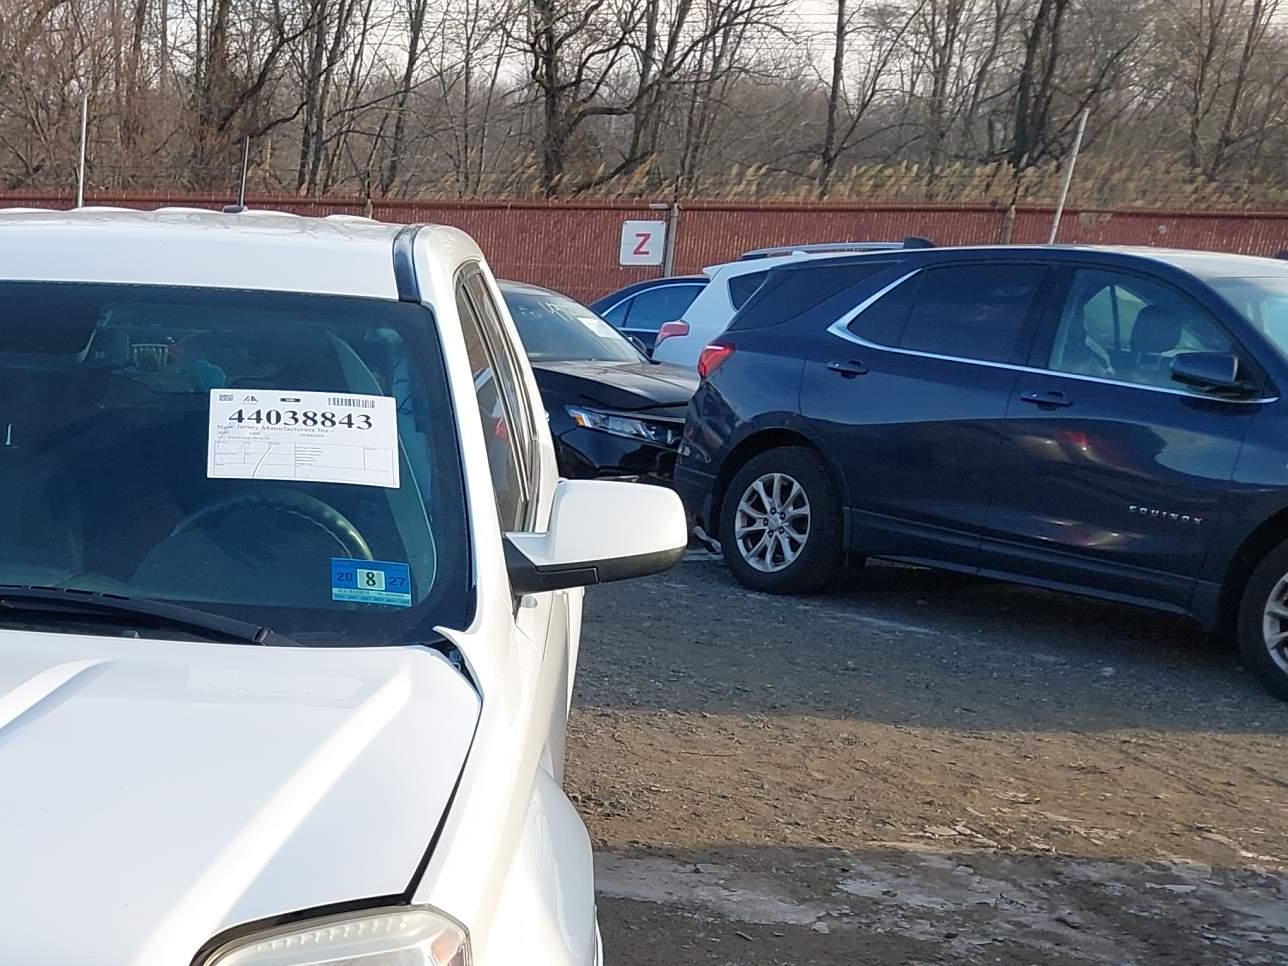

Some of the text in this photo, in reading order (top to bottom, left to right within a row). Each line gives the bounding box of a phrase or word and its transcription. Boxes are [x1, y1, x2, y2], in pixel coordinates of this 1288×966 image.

[633, 233, 652, 255] Z
[228, 408, 373, 430] 44038843
[1128, 505, 1202, 525] EQUINOX
[336, 571, 406, 587] 20 8 27
